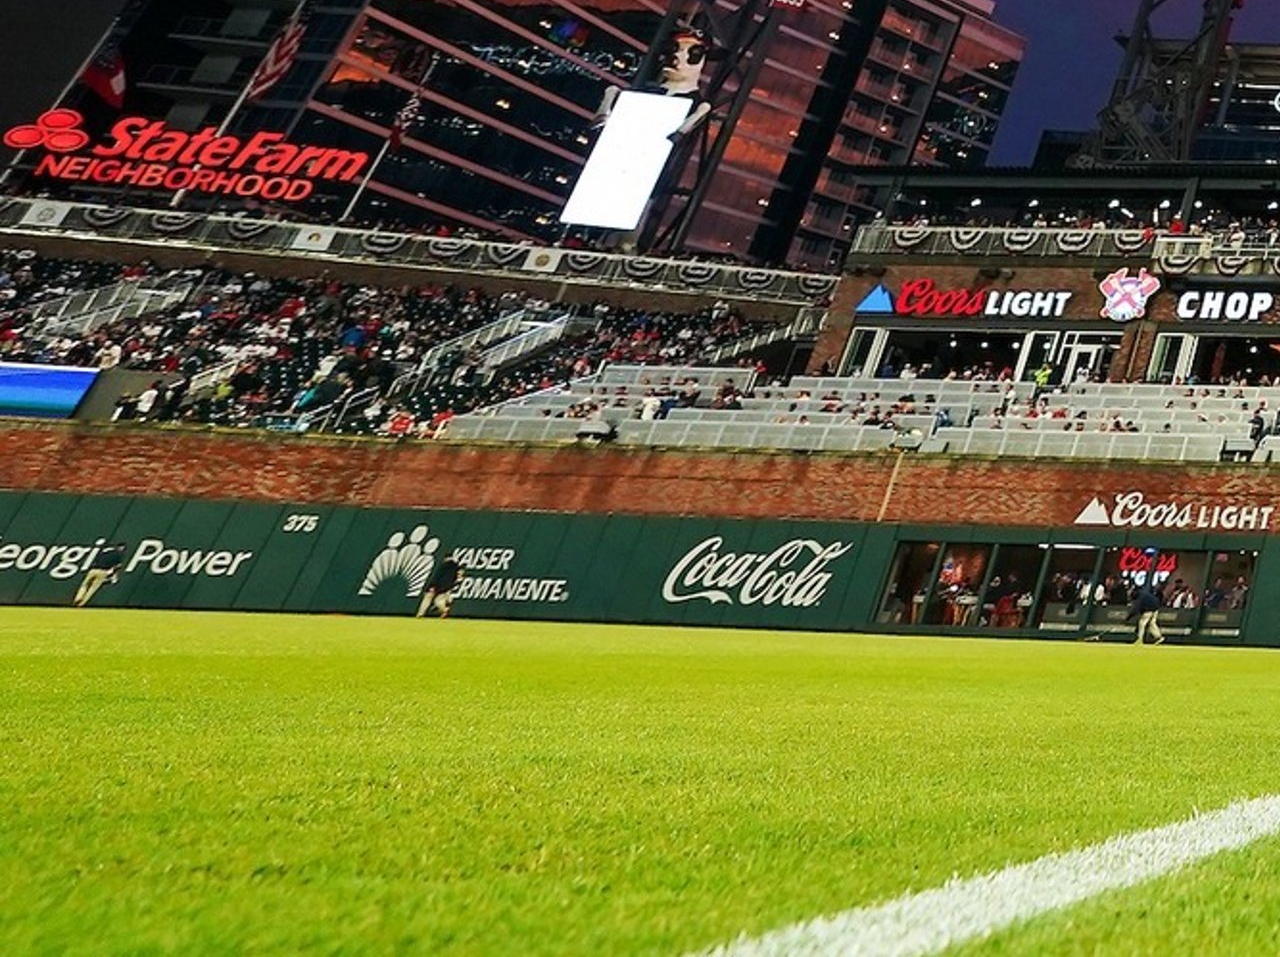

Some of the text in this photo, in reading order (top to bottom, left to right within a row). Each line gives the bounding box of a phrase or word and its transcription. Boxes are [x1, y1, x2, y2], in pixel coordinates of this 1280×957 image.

[34, 155, 314, 202] NEIGHBORHOOD
[893, 278, 1073, 317] Coors LIGHT
[1177, 291, 1273, 321] CHOP
[283, 515, 319, 533] 375
[1110, 491, 1274, 531] Coors LIGHT
[0, 535, 253, 579] eorgi Power
[452, 548, 515, 570] KAISER
[661, 535, 853, 608] Coca-Cola
[452, 577, 568, 601] ERMANENTE
